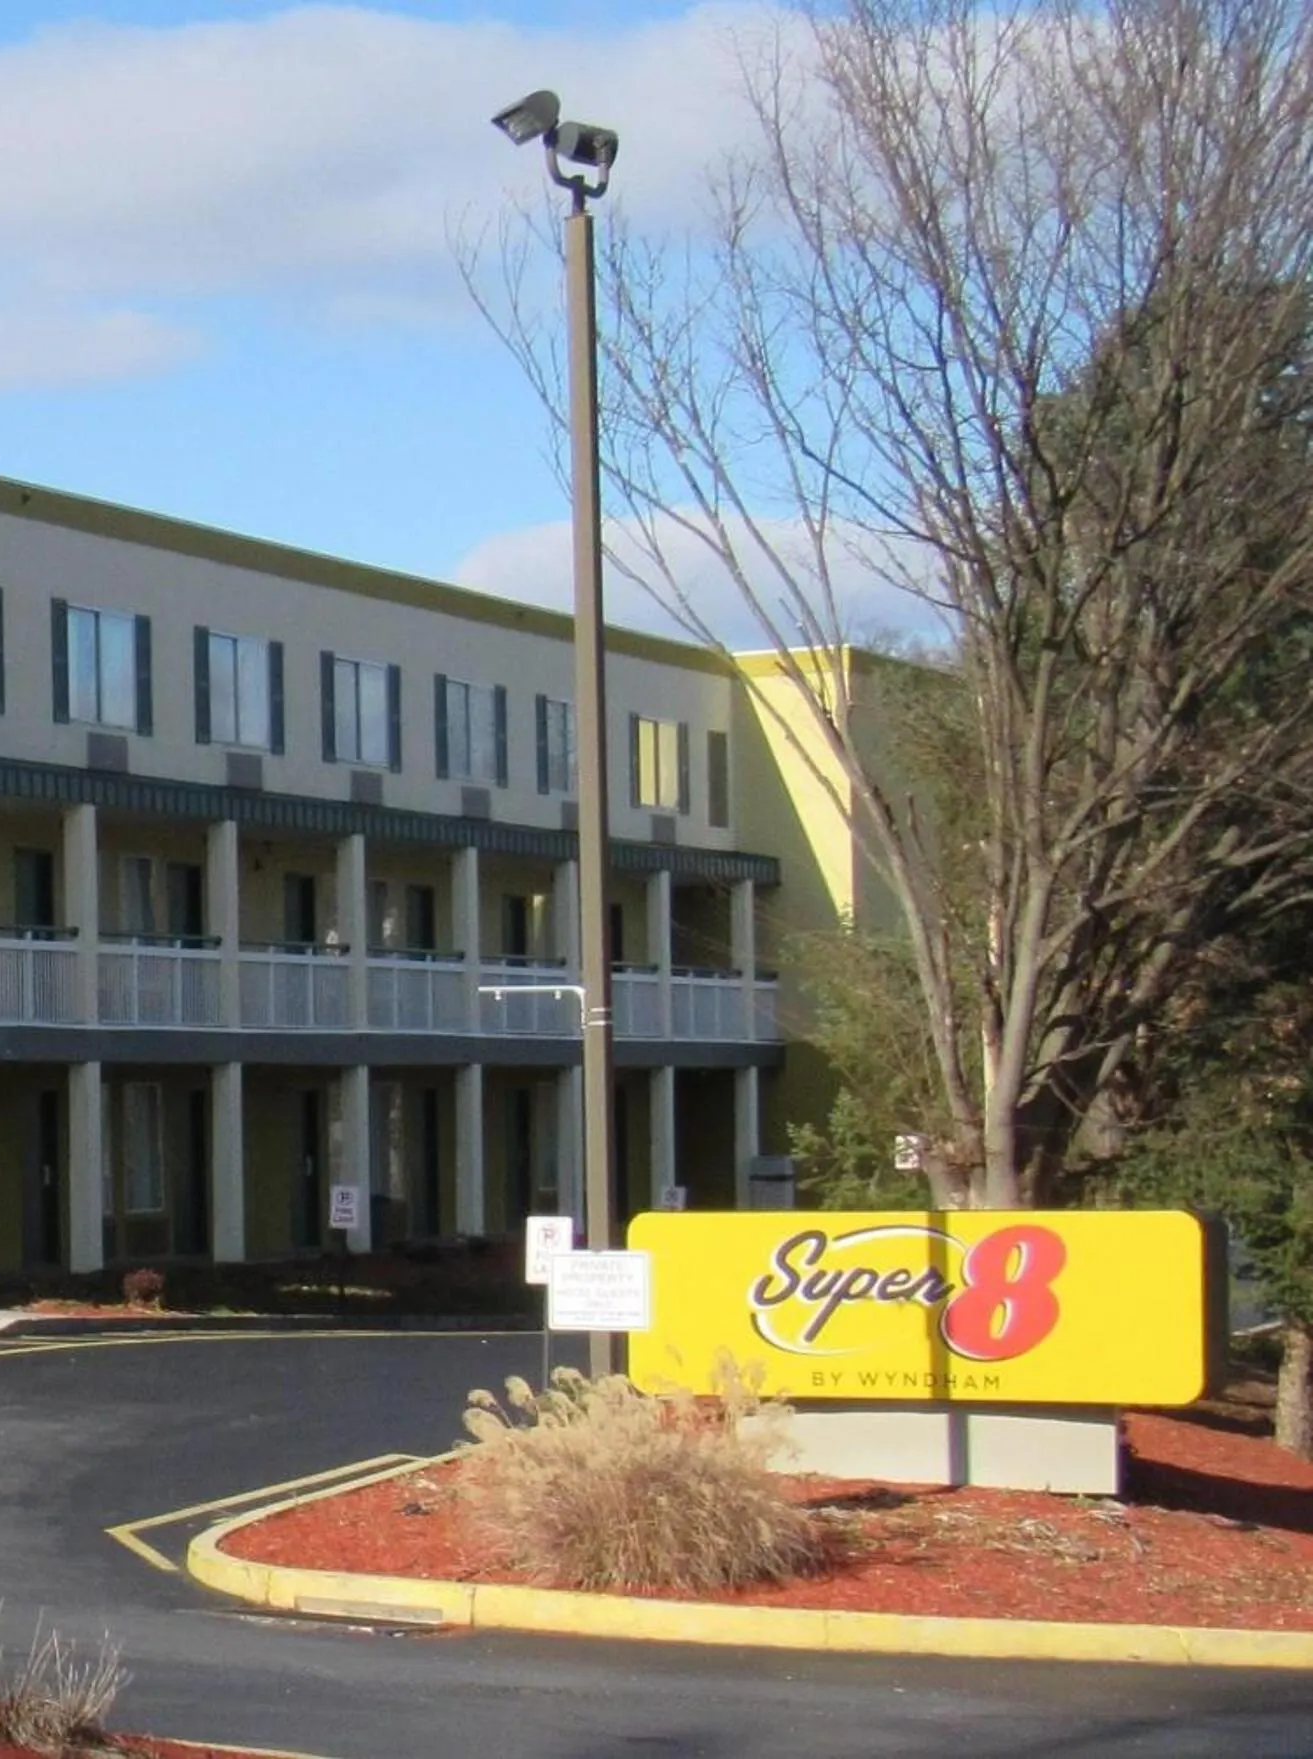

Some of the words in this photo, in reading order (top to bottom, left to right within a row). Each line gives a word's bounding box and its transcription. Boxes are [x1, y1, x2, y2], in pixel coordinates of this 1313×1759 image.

[753, 1230, 955, 1343] Super
[941, 1224, 1067, 1361] 8
[811, 1371, 843, 1388] BY
[858, 1371, 1002, 1391] WYNDHAM
